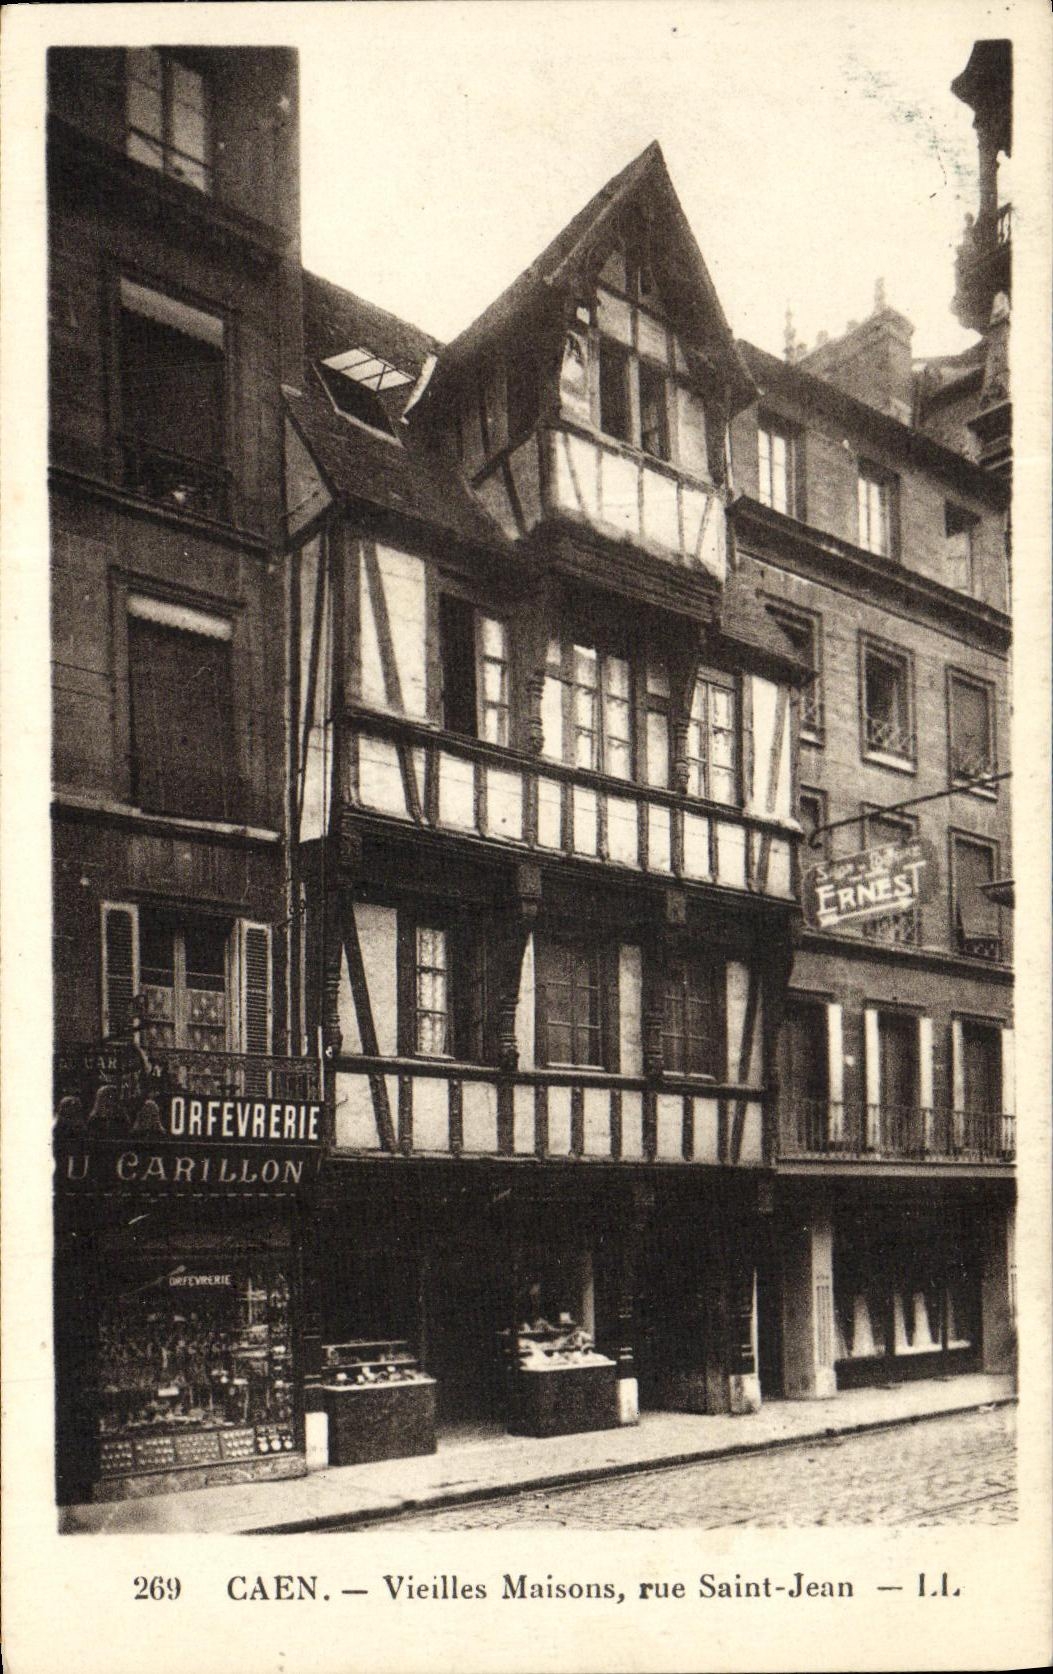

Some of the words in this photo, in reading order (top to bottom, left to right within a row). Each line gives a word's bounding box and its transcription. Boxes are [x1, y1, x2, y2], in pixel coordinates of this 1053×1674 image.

[815, 860, 926, 915] ERNEST
[171, 1096, 320, 1140] ORFEVRERIE
[67, 1155, 90, 1181] U
[116, 1151, 304, 1184] CARILLON
